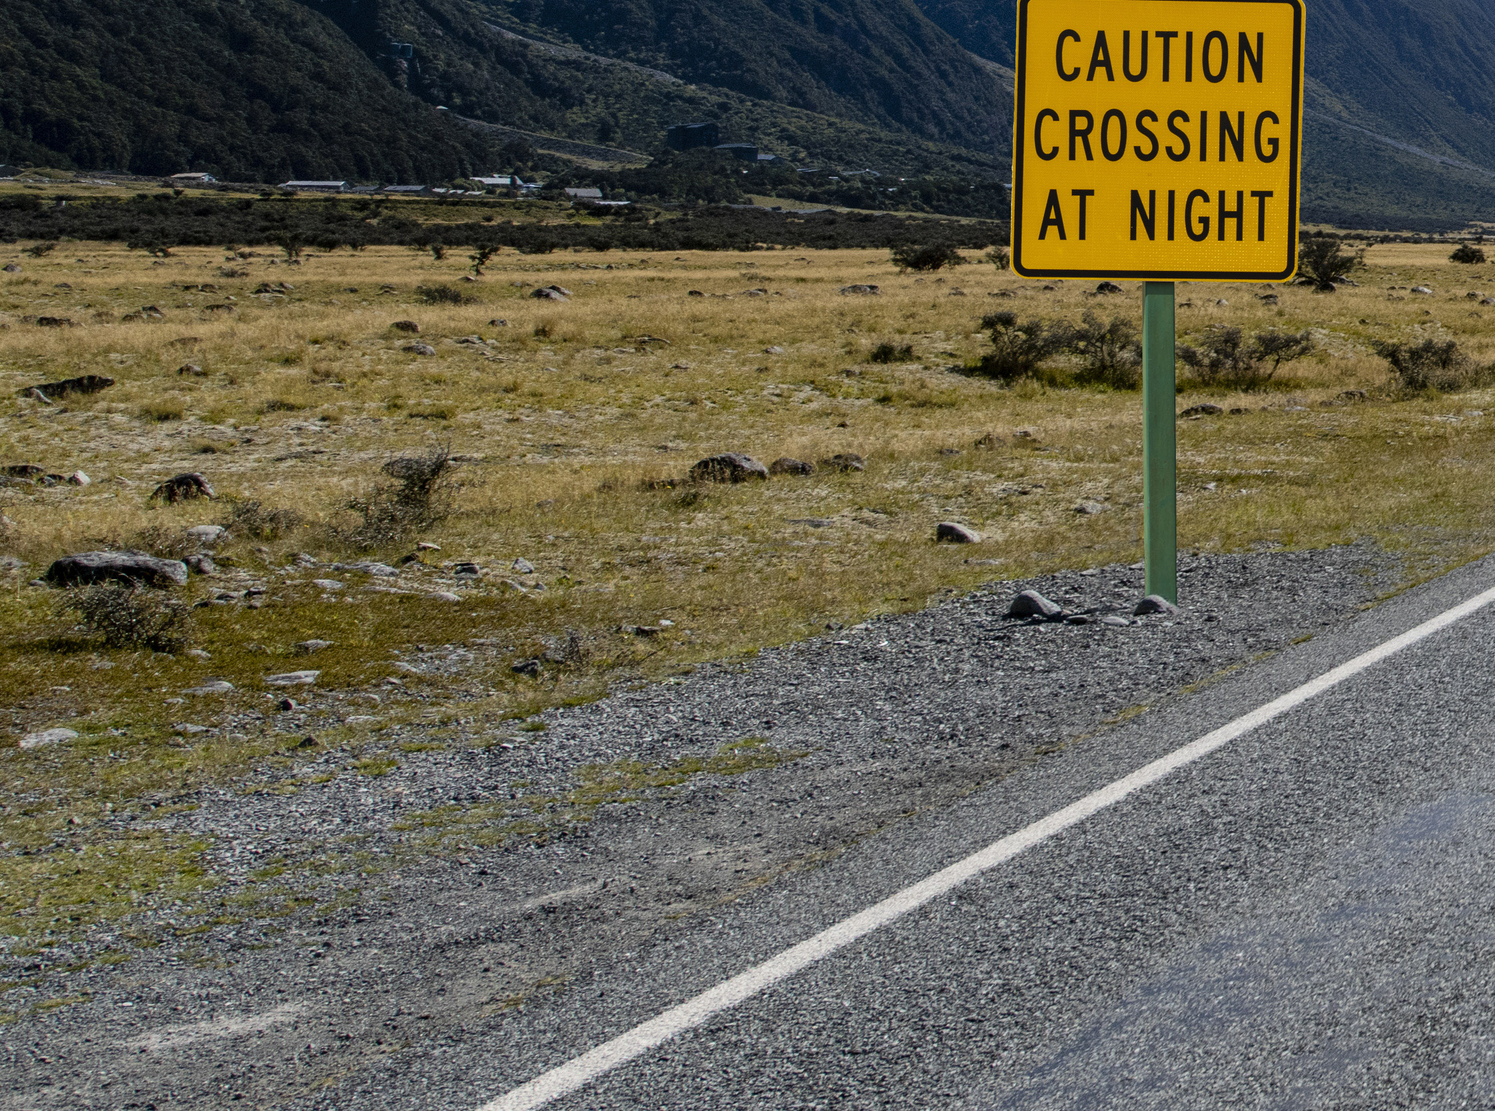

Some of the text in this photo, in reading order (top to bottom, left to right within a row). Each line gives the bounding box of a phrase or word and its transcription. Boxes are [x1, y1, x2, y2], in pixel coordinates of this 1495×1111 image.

[1055, 28, 1264, 83] CAUTION
[1034, 108, 1280, 163] CROSSING
[1038, 188, 1274, 242] AT NIGHT
